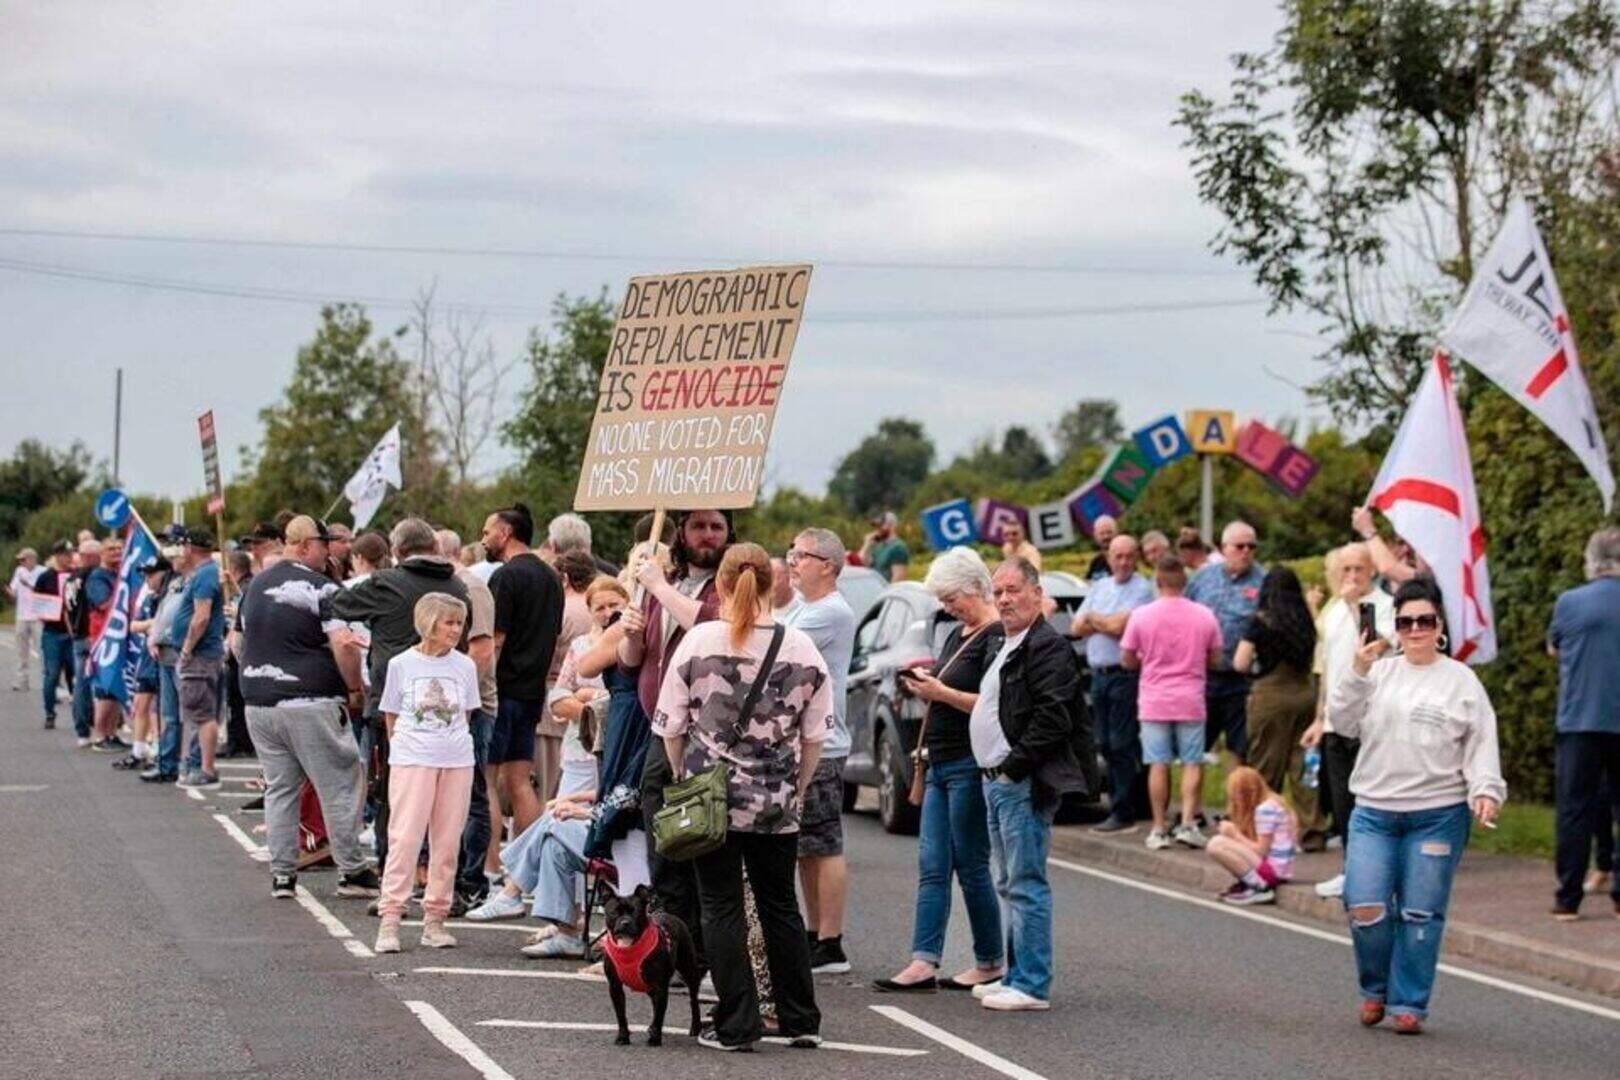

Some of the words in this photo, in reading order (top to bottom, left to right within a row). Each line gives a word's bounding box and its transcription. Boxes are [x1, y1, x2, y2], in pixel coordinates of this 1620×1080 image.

[621, 269, 807, 320] DEMOGRAPHIC
[608, 318, 794, 367] REPLACEMENT
[600, 371, 636, 413] IS
[640, 364, 785, 411] GENOCIDE
[658, 416, 722, 452] VOTED
[725, 412, 767, 446] FOR
[587, 457, 640, 498] MASS
[646, 454, 763, 496] MIGRATION
